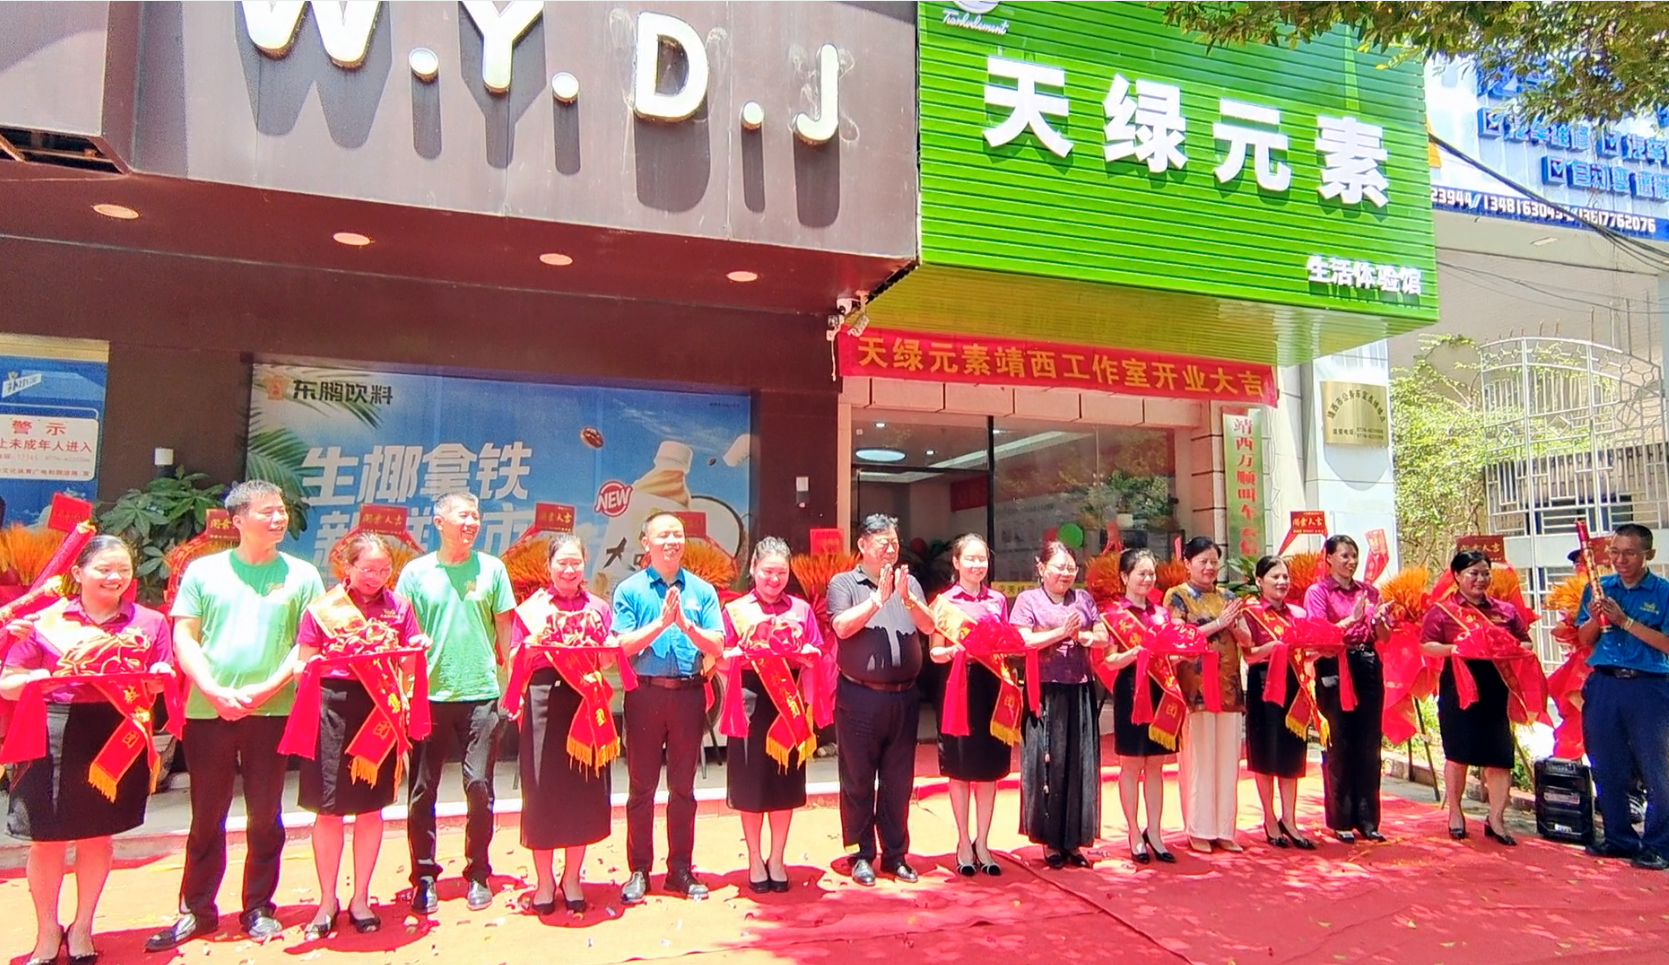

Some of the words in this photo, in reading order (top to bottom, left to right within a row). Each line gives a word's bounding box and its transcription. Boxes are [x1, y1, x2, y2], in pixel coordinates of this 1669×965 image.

[983, 54, 1390, 208] 天绿元素
[1306, 254, 1421, 295] 生活体验馆
[857, 335, 1264, 397] 天绿元素靖西工作室开业大吉
[293, 379, 393, 405] 东鹏饮料
[12, 420, 67, 436] 警示
[301, 441, 532, 506] 生椰拿铁
[594, 485, 633, 513] NEW
